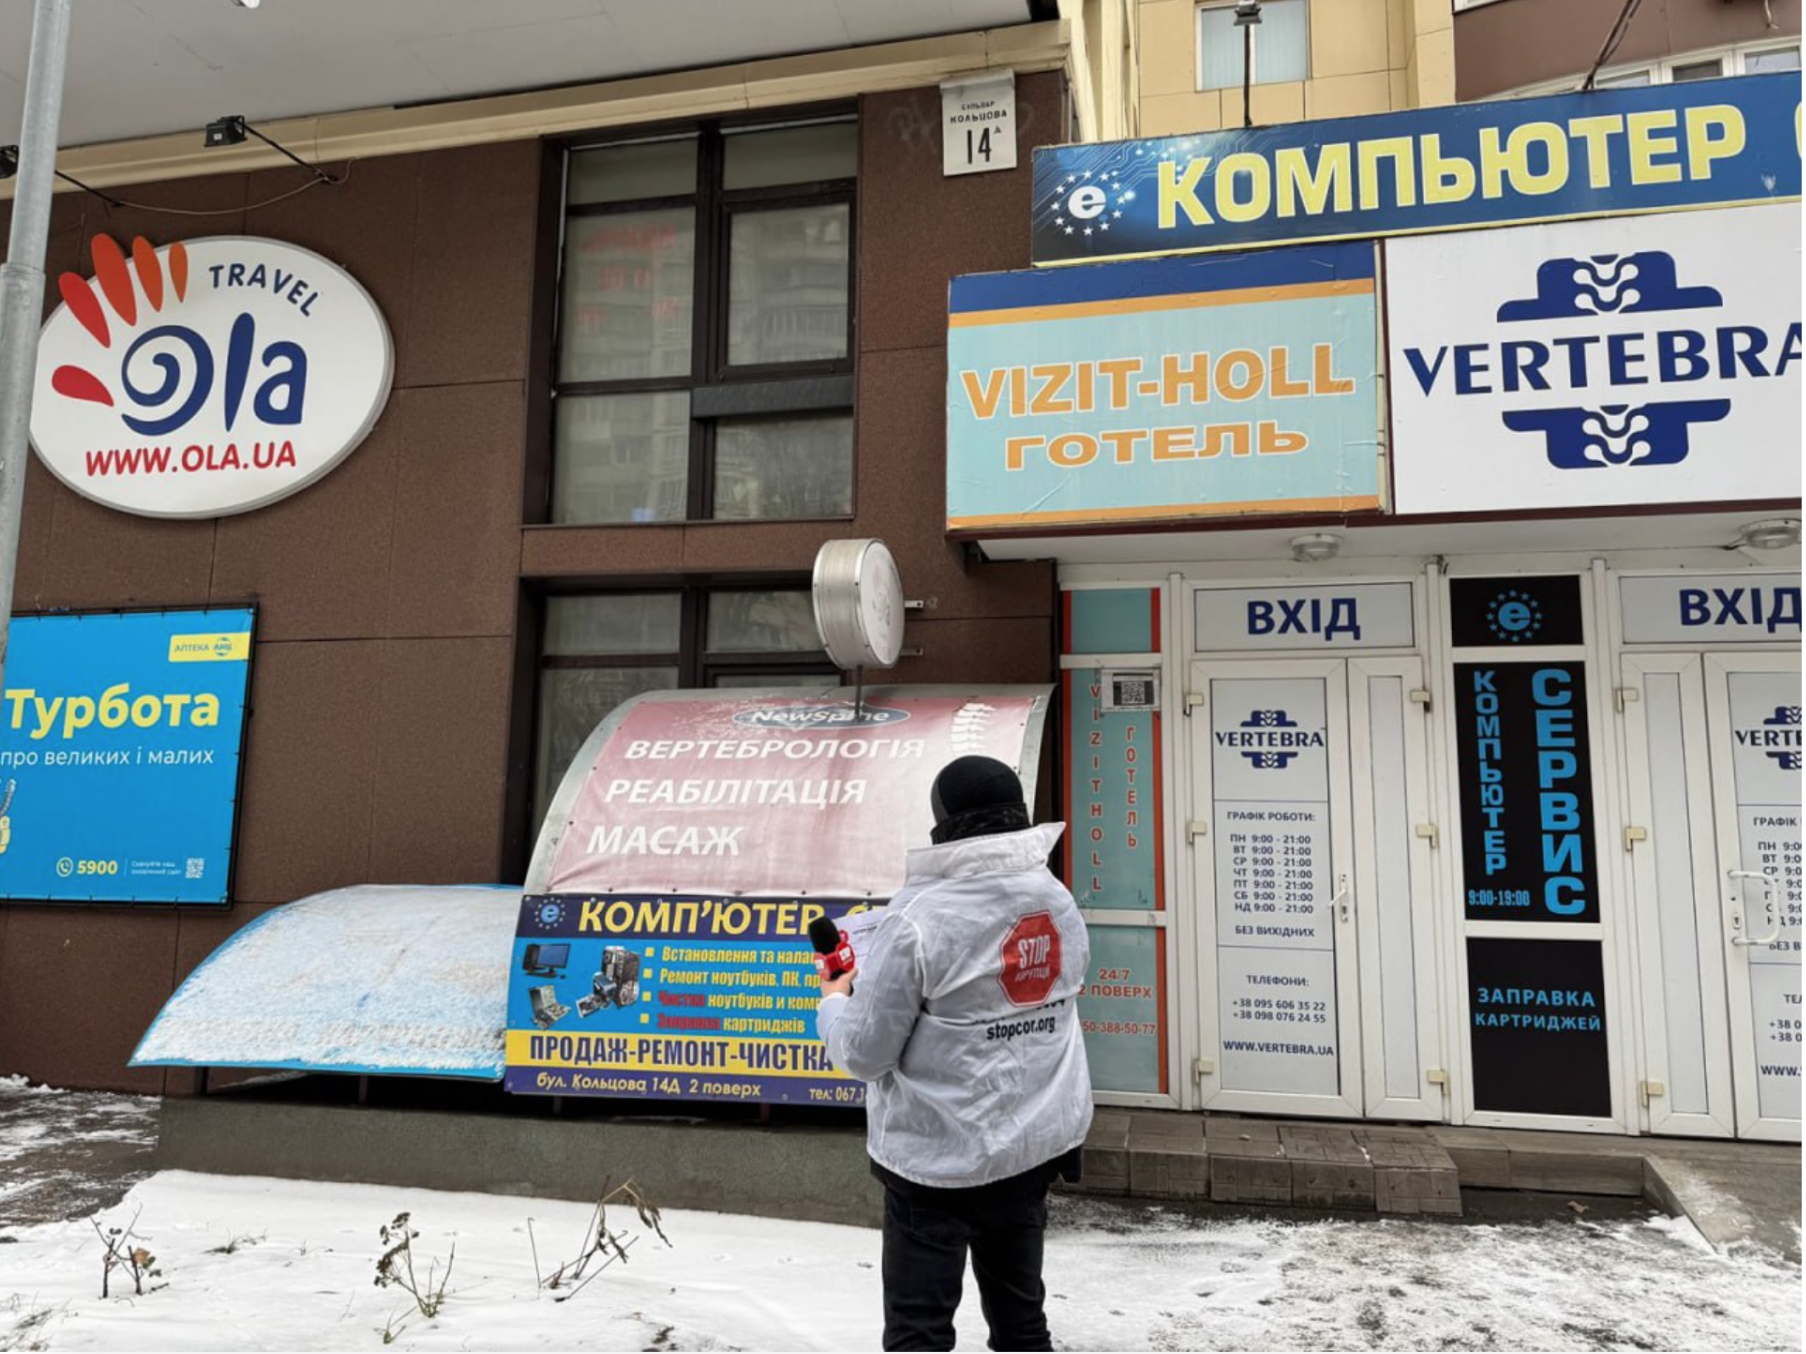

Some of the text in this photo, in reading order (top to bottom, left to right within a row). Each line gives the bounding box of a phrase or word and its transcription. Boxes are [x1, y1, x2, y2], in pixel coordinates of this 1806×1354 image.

[950, 109, 1007, 124] КОЛЬЦОВА
[1158, 104, 1746, 229] КОМПЬЮТЕР
[209, 263, 323, 317] TRAVEL
[959, 343, 1356, 420] VIZIT-HOLL
[1005, 420, 1308, 471] ГОТЕЛЬ
[86, 441, 297, 476] WWW.OLA.UA
[1679, 587, 1802, 633] ВХІД
[1247, 598, 1361, 641] ВХІД
[175, 643, 209, 653] АПТЕКА
[5, 682, 221, 739] Турбота
[1215, 731, 1324, 748] VERTEBRA
[0, 746, 214, 769] про великих і малих
[624, 739, 925, 760] ВЕРТЕБРОЛОГІЯ
[1474, 670, 1507, 875] КОМПЬЮТЕР
[605, 778, 867, 809] РЕАБІЛІТАЦІЯ
[1126, 726, 1137, 848] ГОТЕЛЬ
[1532, 669, 1586, 915] СЕРВИС
[1227, 811, 1316, 822] ГРАФІК РОБОТИ:
[1753, 817, 1797, 827] ГРАФІК
[586, 825, 743, 857] МАСАЖ
[1230, 834, 1246, 843] ПН
[1251, 834, 1273, 844] 9:00
[1283, 835, 1311, 845] 21:00
[1758, 842, 1776, 851] ПН
[1233, 846, 1246, 854] ВТ
[1252, 846, 1273, 855] 9:00
[1283, 846, 1311, 856] 21:00
[1762, 854, 1777, 863] ВТ
[77, 860, 118, 875] 5900
[1233, 857, 1247, 866] СР
[1252, 857, 1274, 867] 9:00
[1284, 858, 1312, 867] 21:00
[1233, 868, 1247, 877] ЧТ
[1253, 869, 1275, 878] 9:00
[1285, 870, 1312, 879] 21:00
[1763, 866, 1778, 875] СР
[1234, 880, 1247, 889] ПТ
[1253, 880, 1275, 890] 9:00
[1285, 881, 1313, 891] 21:00
[1234, 891, 1248, 900] СБ
[1253, 892, 1275, 901] 9:00
[1285, 893, 1313, 902] 21:00
[1235, 903, 1251, 914] НД
[1254, 903, 1275, 912] 9:00
[1285, 904, 1314, 914] 21:00
[1235, 925, 1315, 938] БЕЗ ВИХІДНИХ
[662, 946, 757, 963] Встановлення
[760, 951, 775, 963] та
[1018, 934, 1051, 969] STOP
[660, 968, 709, 984] Ремонт
[1246, 974, 1309, 987] ТЕЛЕФОНИ:
[1091, 985, 1152, 998] ПОВЕРХ
[1477, 987, 1595, 1007] ЗАПРАВКА
[708, 993, 773, 1011] ноутбуків
[776, 996, 785, 1009] и
[1254, 999, 1273, 1008] 095
[1276, 1000, 1295, 1010] 606
[1313, 1002, 1326, 1012] 22
[1254, 1011, 1273, 1021] 098
[1276, 1012, 1295, 1022] 076
[1298, 1013, 1311, 1022] 24
[1314, 1014, 1326, 1023] 55
[1475, 1013, 1600, 1032] КАРТРИДЖЕЙ
[1769, 1019, 1791, 1029] +38
[723, 1017, 806, 1034] картриджів
[986, 1016, 1055, 1041] stopcor.org
[1080, 1020, 1156, 1036] 50-388-50-77
[1770, 1032, 1792, 1042] +38
[1223, 1040, 1334, 1056] WWW.VERTEBRA.UA
[1760, 1065, 1802, 1077] WWW.
[537, 1072, 761, 1098] бул. Кольцова 14Д 2 поверх
[809, 1088, 833, 1100] тел:
